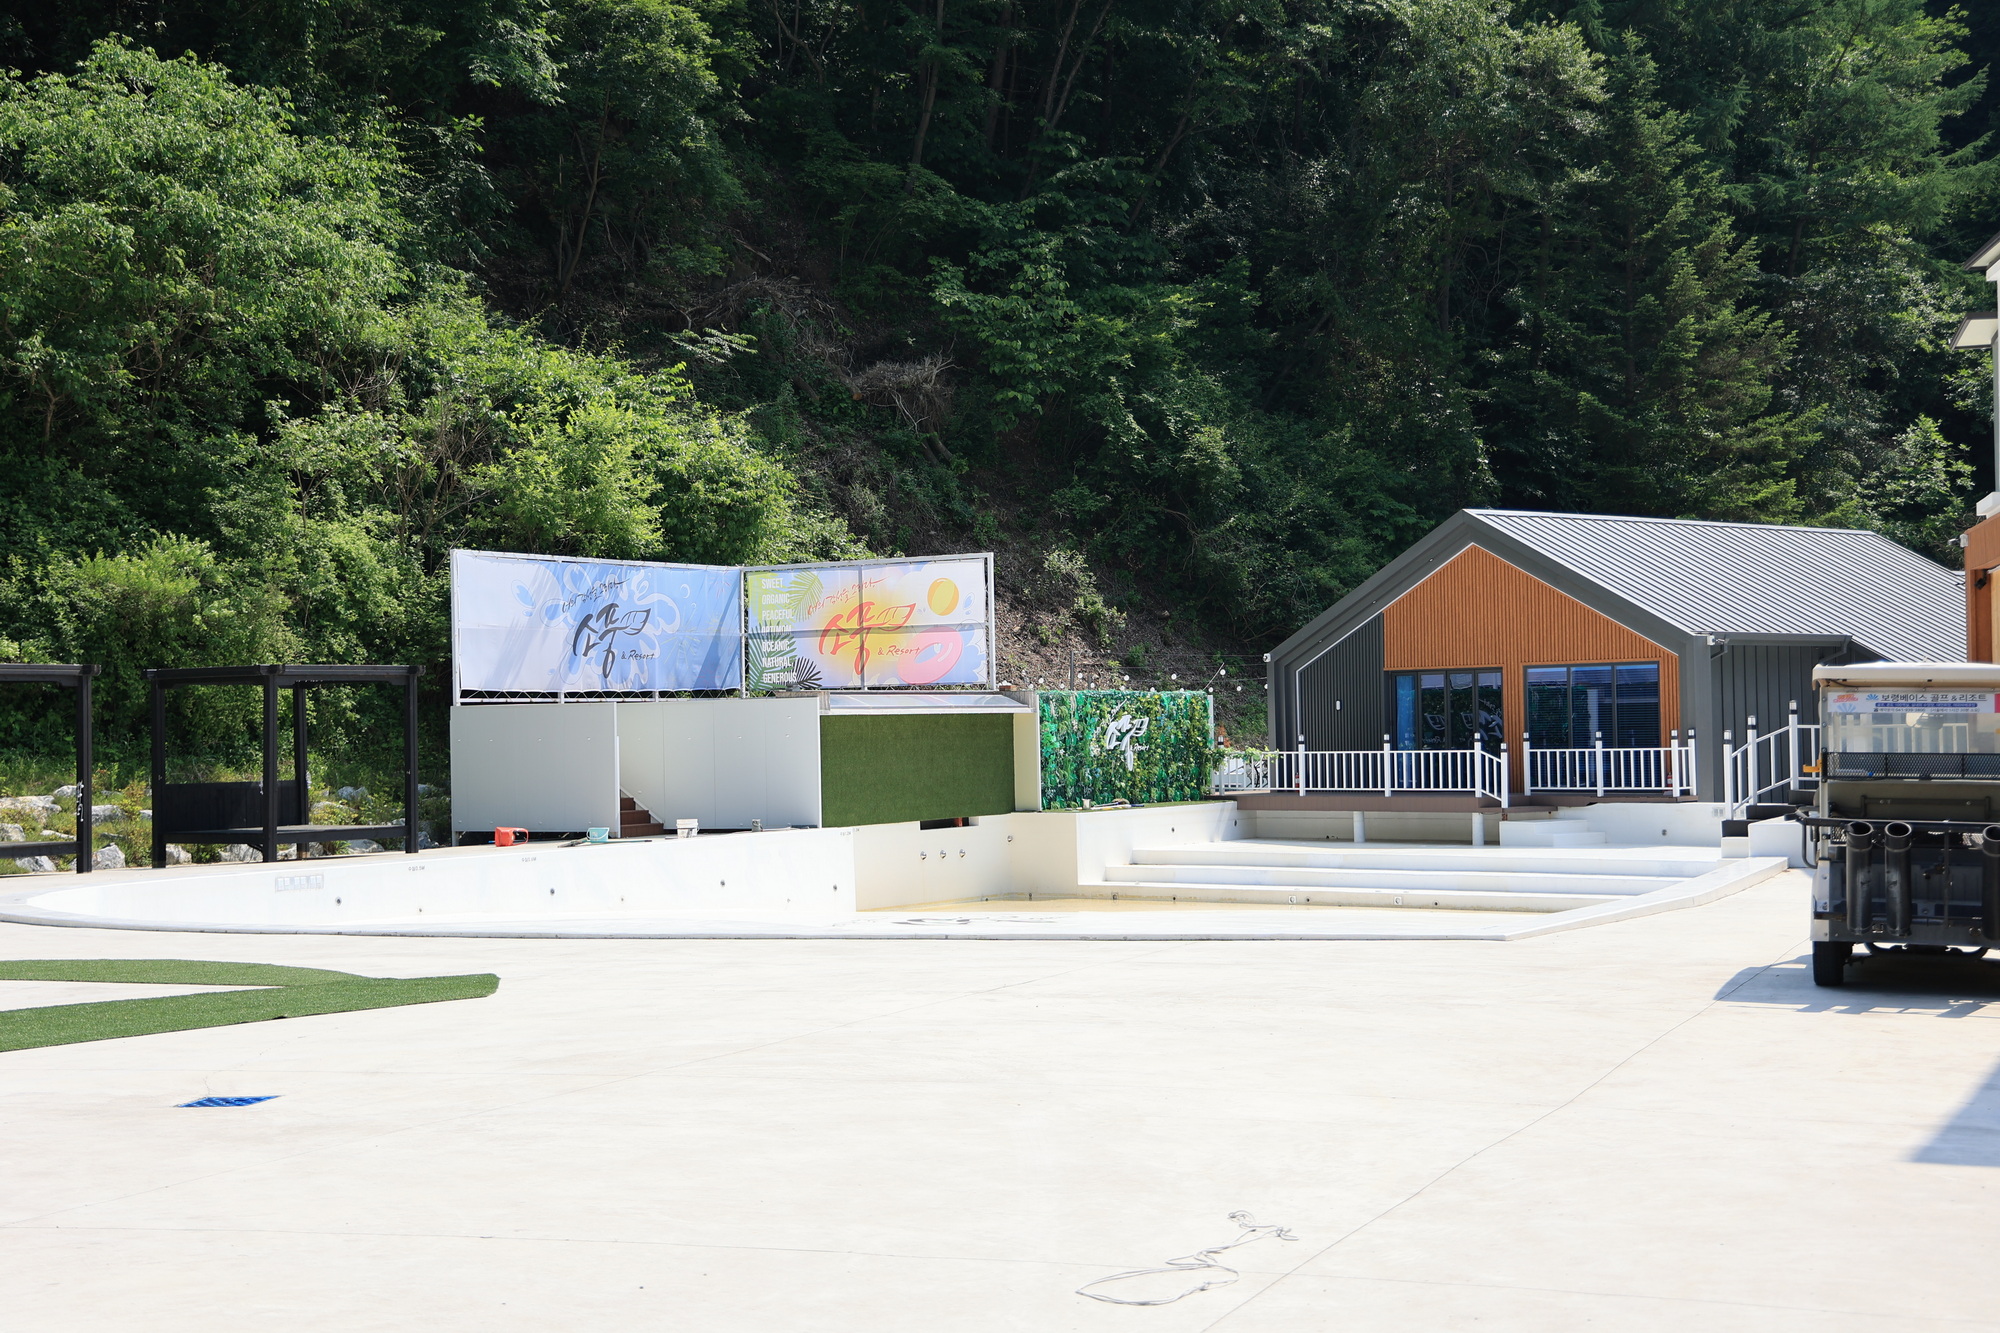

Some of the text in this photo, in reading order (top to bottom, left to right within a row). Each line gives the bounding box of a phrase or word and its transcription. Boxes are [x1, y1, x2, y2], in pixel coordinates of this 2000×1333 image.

[762, 577, 783, 589] SWEET
[762, 593, 790, 605] ORGANIC
[762, 608, 793, 620] PEACEFUL
[762, 640, 789, 652] OCEANIC
[877, 645, 920, 656] & Resort
[628, 649, 654, 660] Resort
[763, 672, 797, 684] GENEROUS
[1881, 693, 1928, 703] 보령베이스
